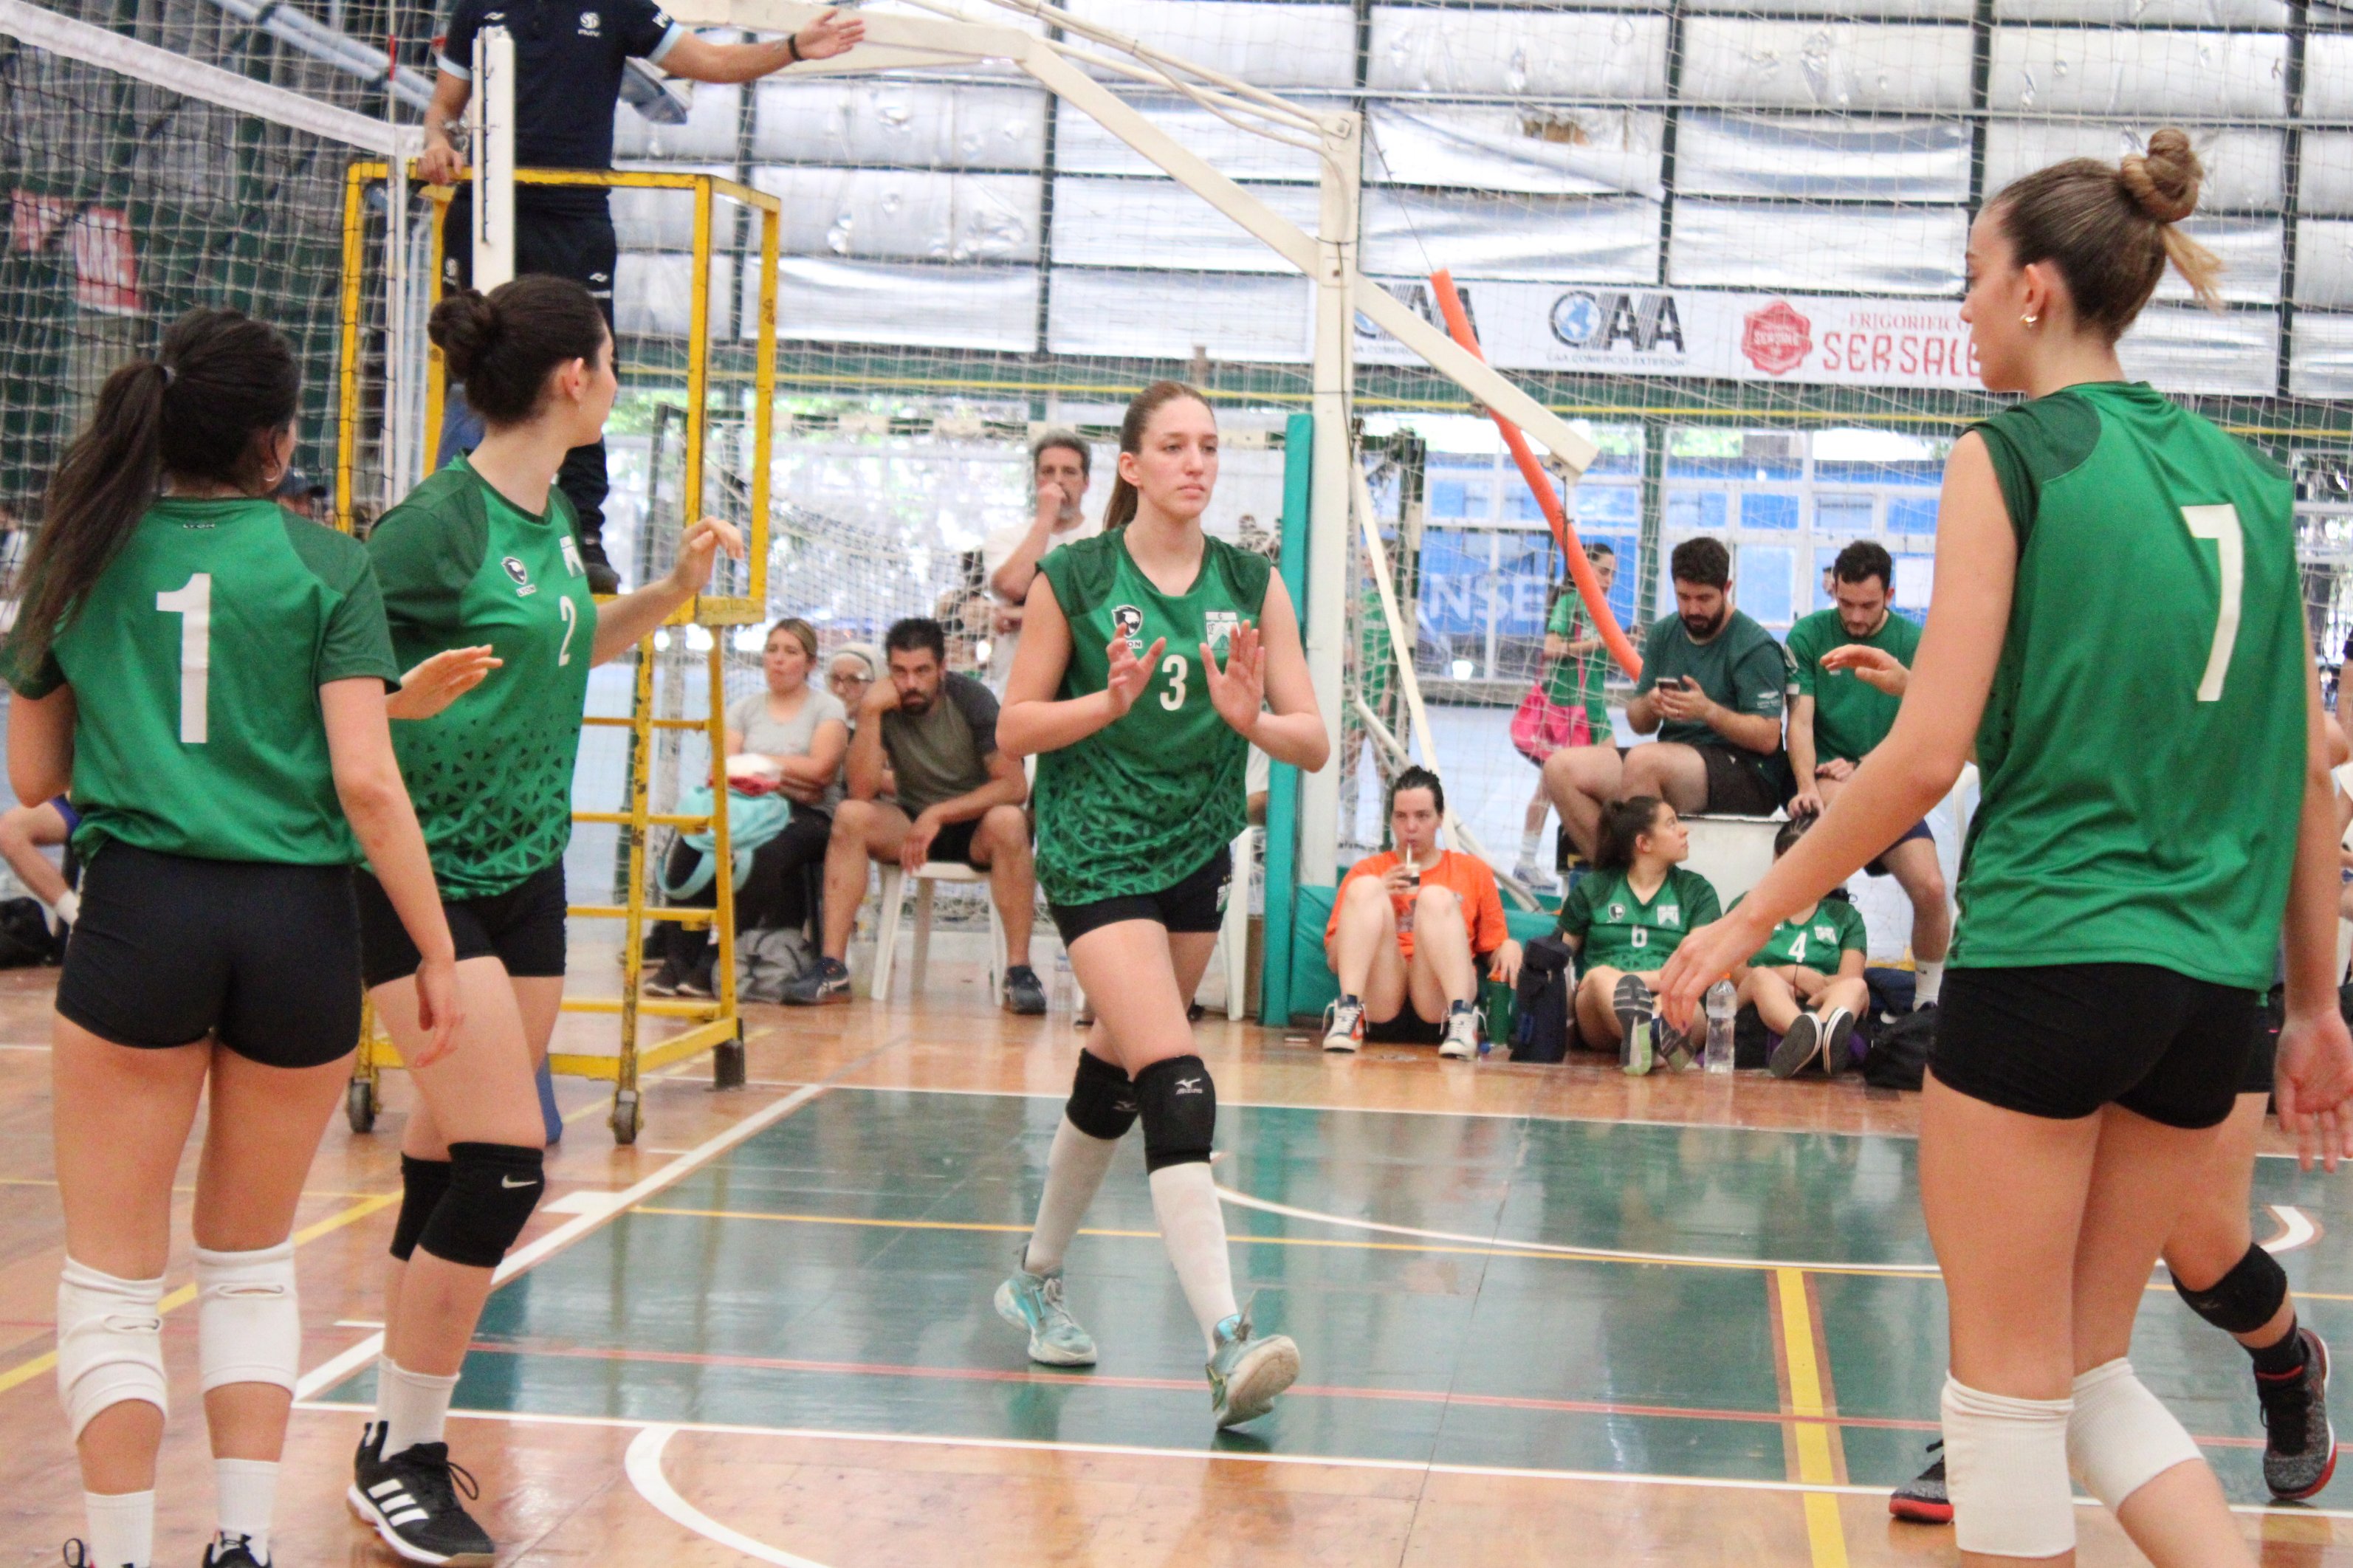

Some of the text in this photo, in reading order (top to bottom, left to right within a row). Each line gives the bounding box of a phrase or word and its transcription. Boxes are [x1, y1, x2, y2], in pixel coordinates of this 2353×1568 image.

[1549, 290, 1686, 353] CAA
[1823, 332, 1981, 377] SERSALE
[518, 585, 536, 596] LYON
[2179, 503, 2243, 701] 7
[157, 573, 210, 743] 1
[559, 596, 576, 666] 2
[1160, 654, 1188, 711] 3
[1632, 924, 1647, 947] 6
[1788, 932, 1807, 963] 4
